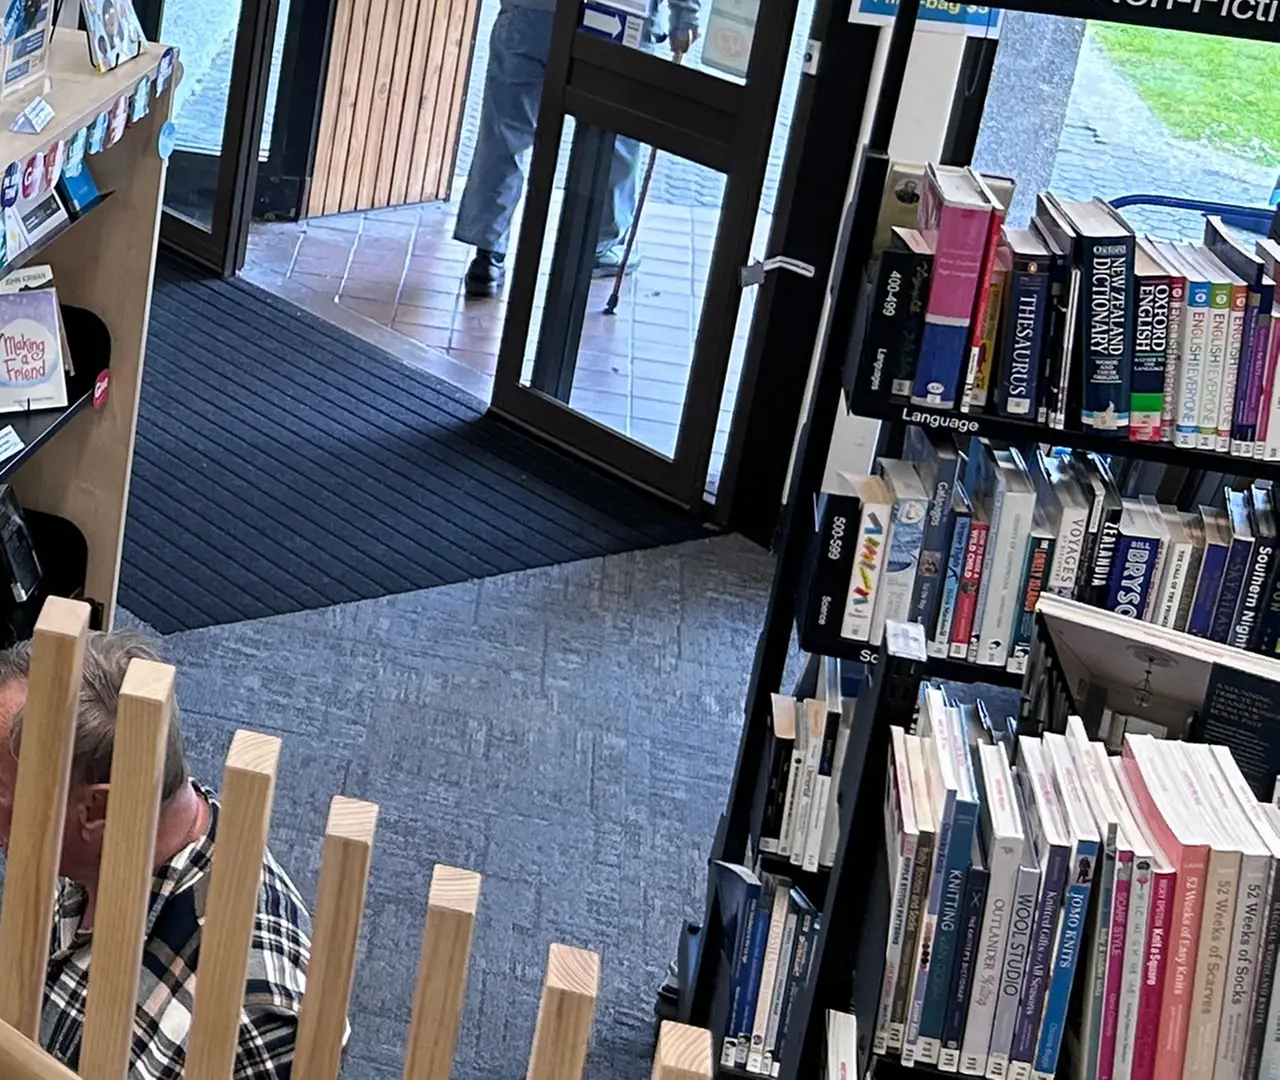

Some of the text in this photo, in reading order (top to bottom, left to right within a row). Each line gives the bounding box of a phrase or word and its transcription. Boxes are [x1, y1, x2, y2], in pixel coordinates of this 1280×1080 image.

[1093, 245, 1127, 255] Oxford
[883, 270, 903, 317] 400-499
[1090, 258, 1111, 355] DICTIONARY
[1109, 257, 1126, 355] NEW ZEALAND
[1135, 285, 1155, 352] ENGLISH
[1151, 285, 1170, 353] OXFORD
[3, 333, 45, 361] Making
[21, 355, 29, 365] a
[1009, 294, 1038, 396] THESAURUS
[1189, 311, 1205, 362] ENGLISH
[1210, 313, 1225, 366] ENGLISH
[3, 359, 46, 382] Friend
[902, 408, 979, 432] Language
[964, 529, 979, 579] WILD CHILD
[1061, 518, 1085, 583] VOYAGES
[1092, 521, 1119, 587] ZEALANDIA
[1245, 546, 1273, 607] Southern
[1114, 548, 1150, 619] BRYSO
[941, 870, 964, 932] KNITTING
[1183, 889, 1197, 920] Weeks
[1187, 875, 1198, 889] 52
[982, 898, 1006, 970] OUTLANDER
[1003, 894, 1034, 998] WOOL STUDIO
[1059, 892, 1084, 969] JOMO KNITS
[1111, 892, 1128, 957] SCARF STYLE
[1182, 921, 1191, 934] of
[1201, 880, 1231, 1015] 52 Weeks of Scarves
[1233, 884, 1261, 1006] 52 Weeks of Socks
